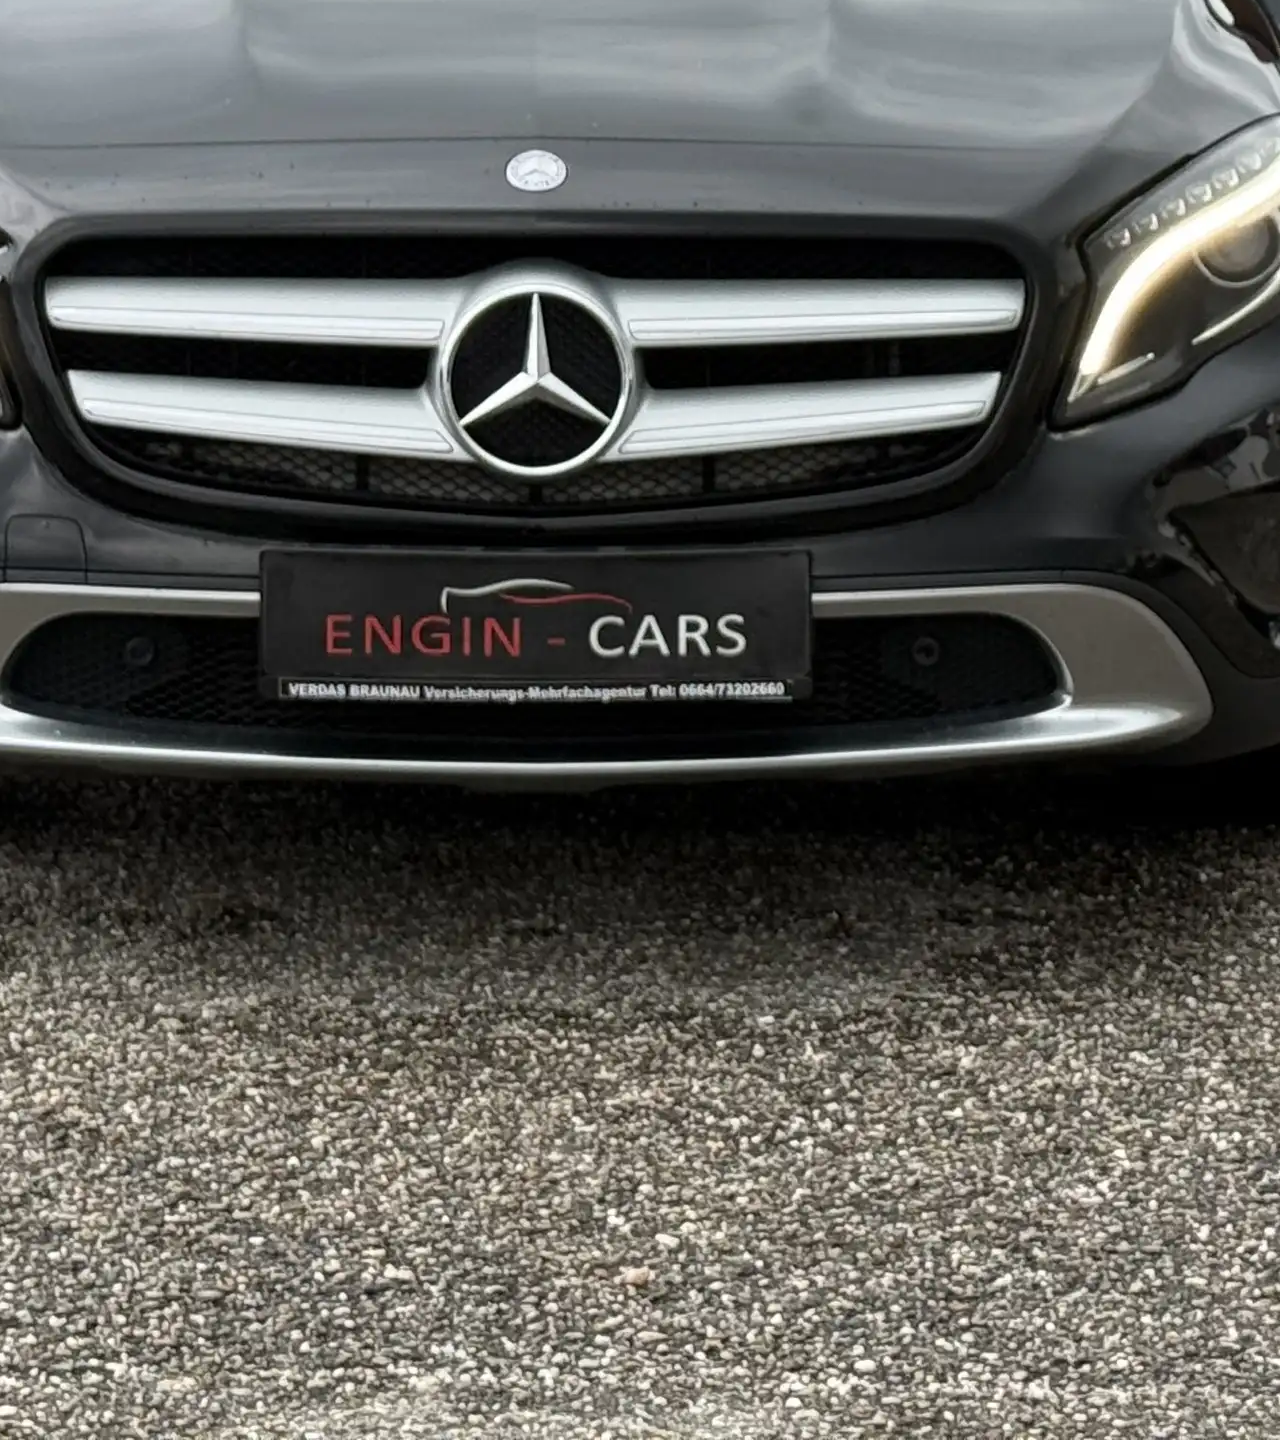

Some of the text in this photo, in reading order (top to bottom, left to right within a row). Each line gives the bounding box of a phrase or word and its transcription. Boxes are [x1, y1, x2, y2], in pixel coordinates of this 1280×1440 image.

[326, 614, 520, 657] ENGIN
[589, 613, 747, 658] CARS
[288, 682, 346, 697] VERDAS
[349, 683, 420, 698] BRAUNAU
